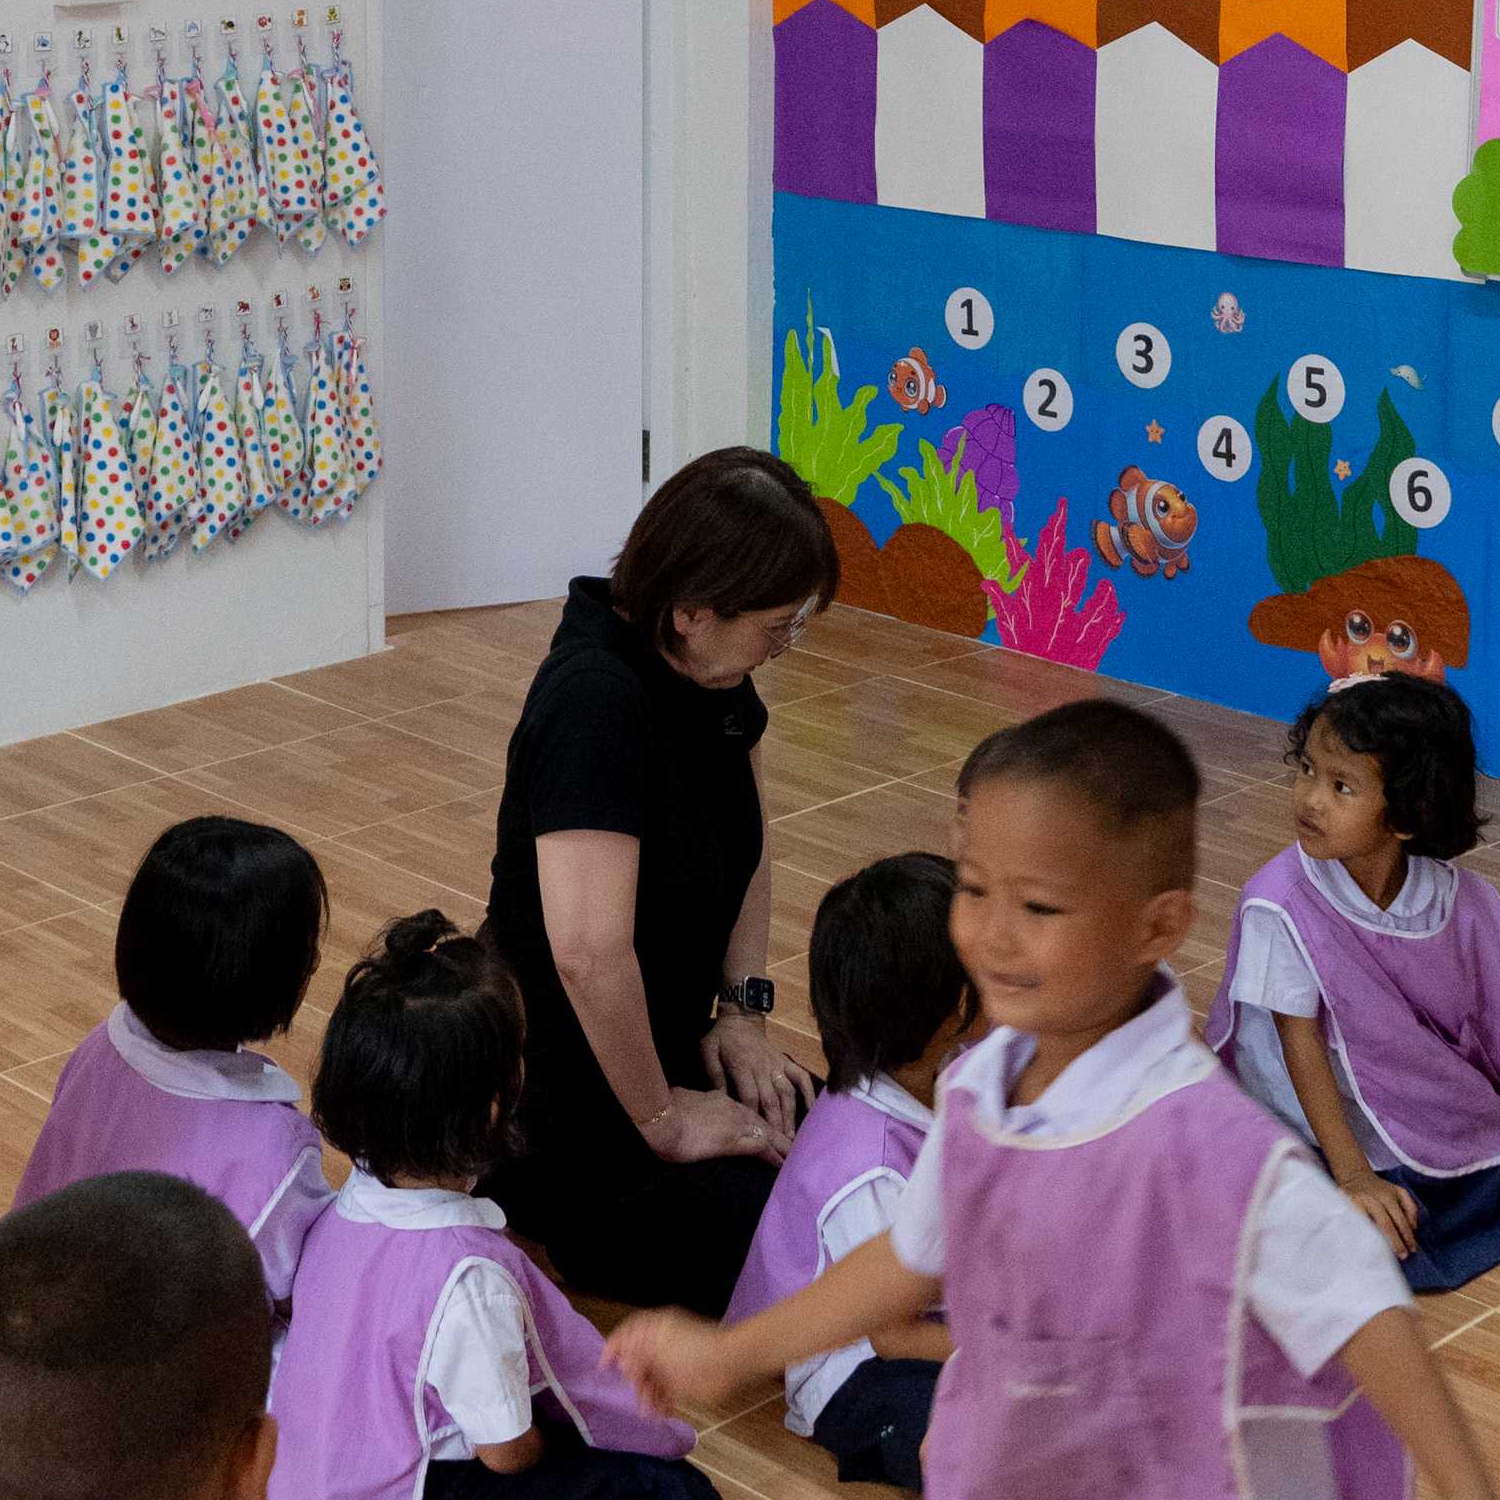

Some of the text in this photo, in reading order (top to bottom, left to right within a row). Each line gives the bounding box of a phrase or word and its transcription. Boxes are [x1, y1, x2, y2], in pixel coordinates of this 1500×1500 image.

[961, 299, 978, 336] 1
[1133, 335, 1153, 373] 3
[1038, 379, 1057, 418] 2
[1305, 367, 1326, 408] 5
[1213, 428, 1236, 468] 4
[1408, 470, 1432, 512] 6
